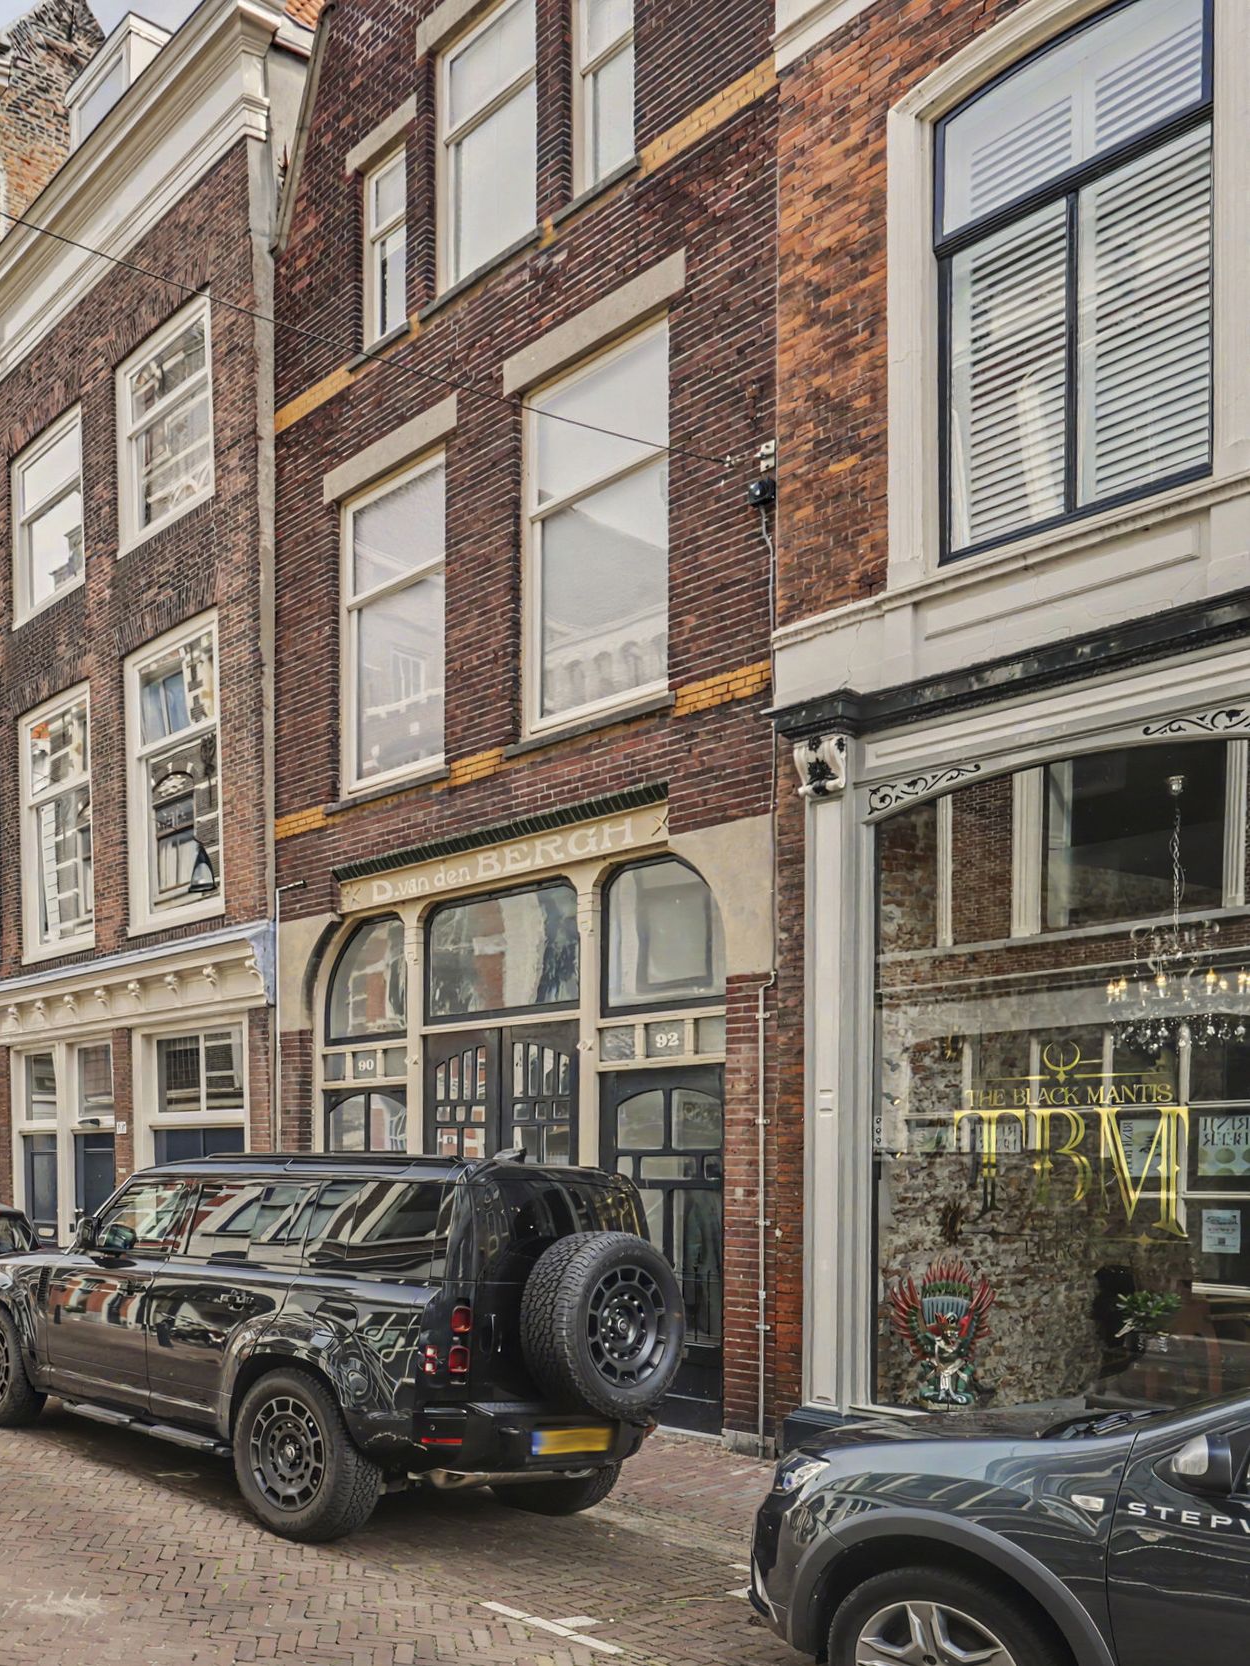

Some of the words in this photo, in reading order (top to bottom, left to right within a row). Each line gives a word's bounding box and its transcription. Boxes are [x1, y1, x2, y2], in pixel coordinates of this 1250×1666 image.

[434, 864, 471, 888] den
[476, 817, 635, 878] BERGH
[655, 1032, 680, 1048] 92
[357, 1058, 375, 1071] 90
[965, 1088, 1006, 1107] THE
[1013, 1086, 1079, 1105] BLACK
[1087, 1082, 1174, 1104] MANTIS
[953, 1106, 1190, 1238] TBM
